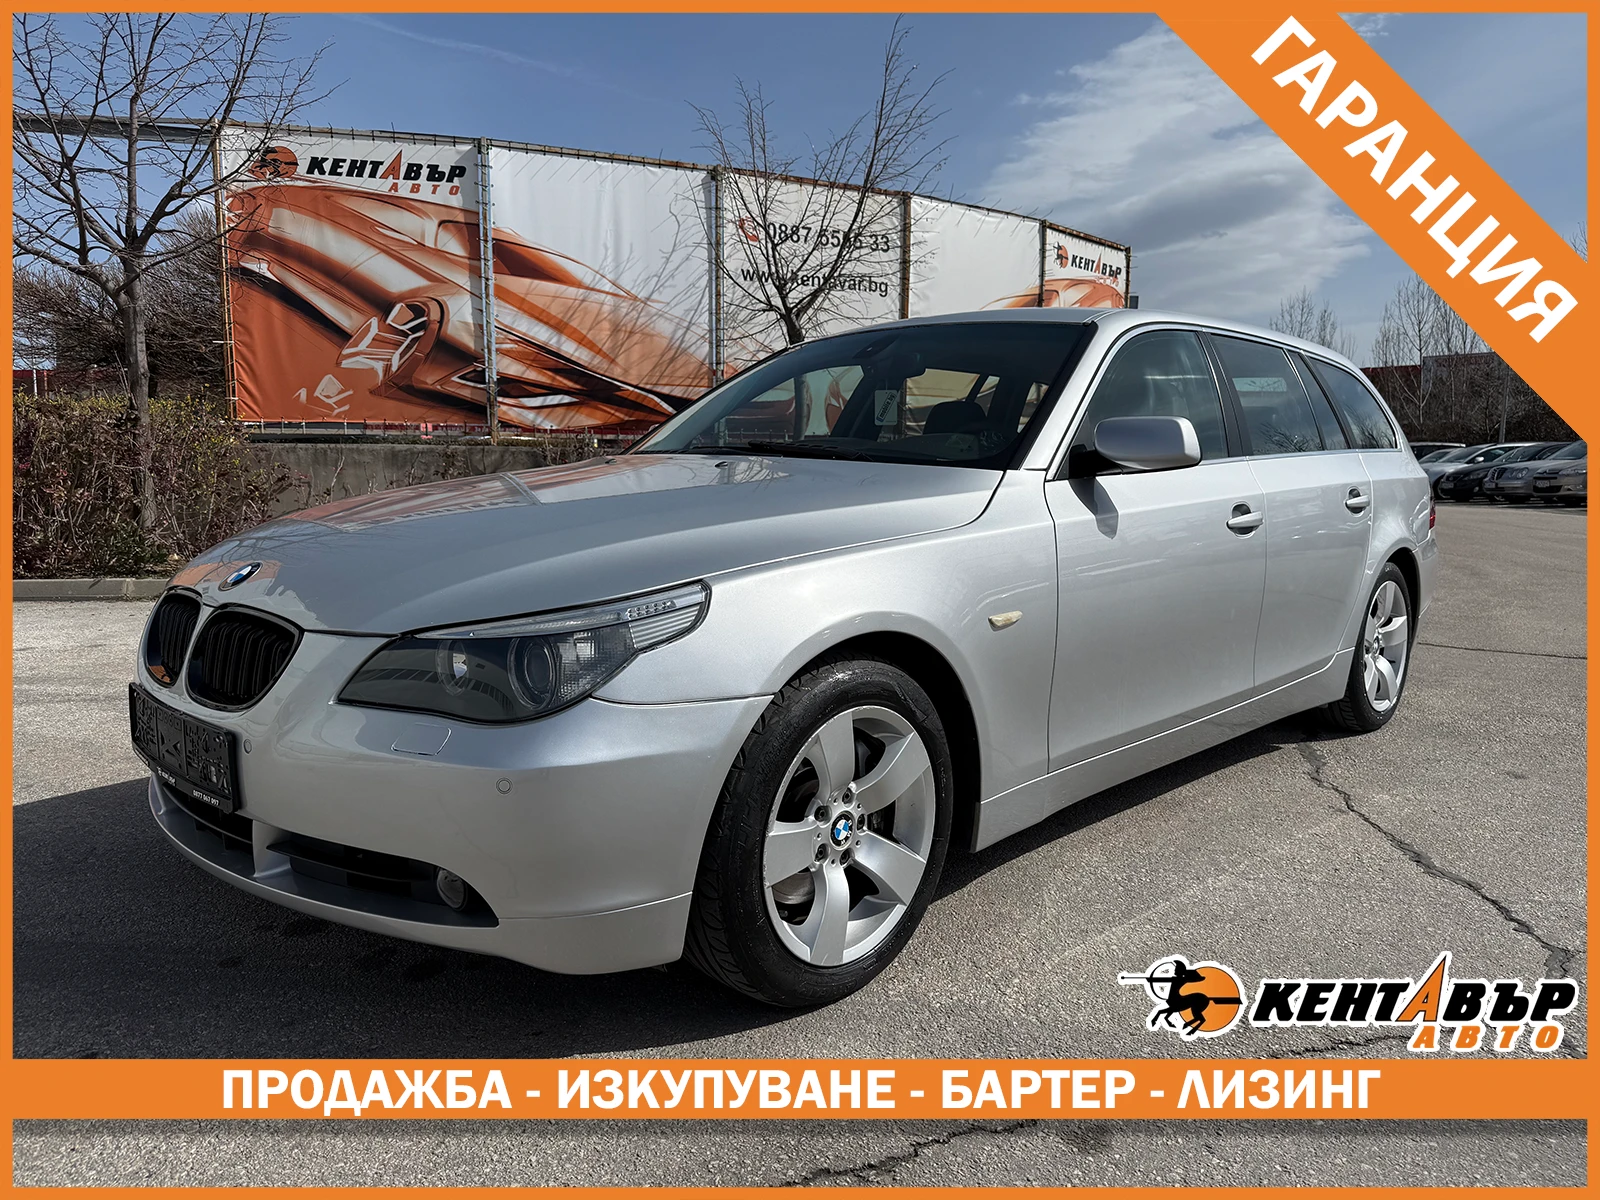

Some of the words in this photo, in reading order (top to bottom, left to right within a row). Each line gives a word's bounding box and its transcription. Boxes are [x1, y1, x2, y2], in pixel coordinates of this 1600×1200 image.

[306, 149, 467, 183] КЕНТАВЪР
[388, 182, 461, 196] АВТО
[767, 222, 812, 243] 0887
[869, 233, 890, 253] 33
[1070, 252, 1122, 278] КЕНТАВЪР
